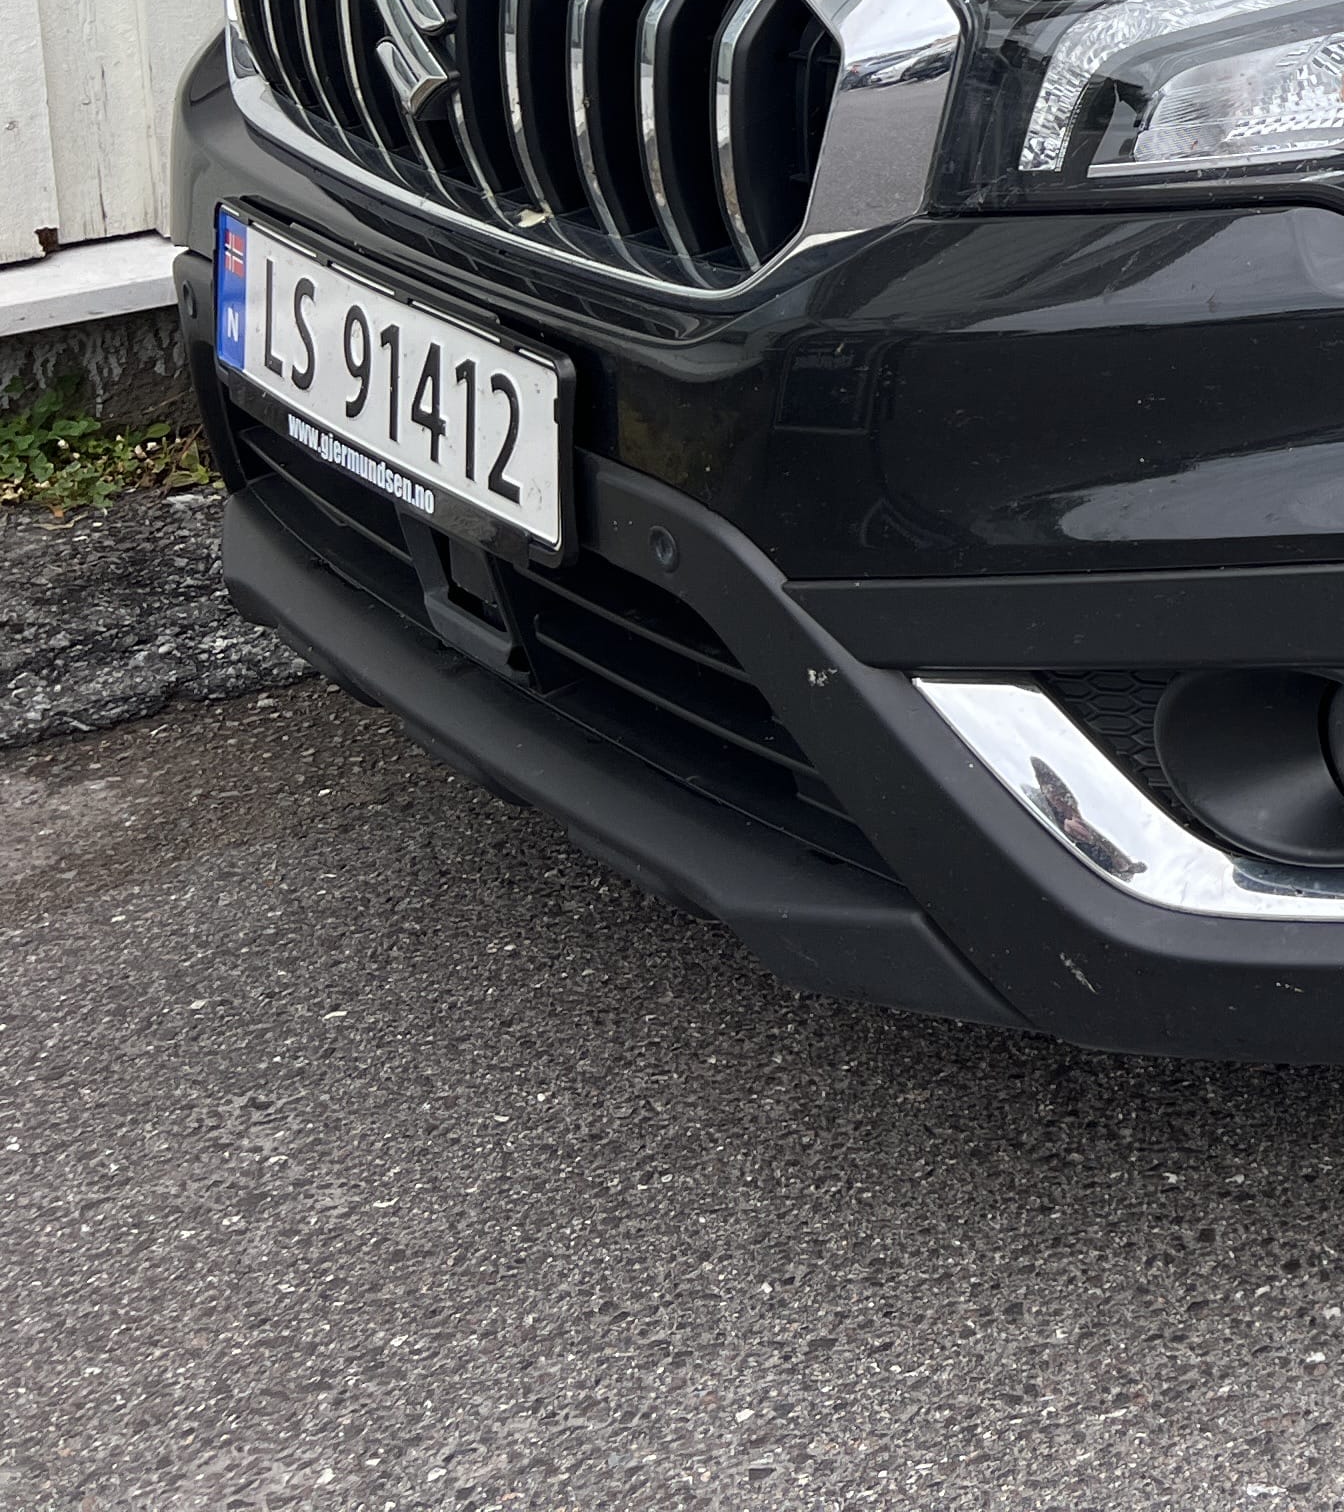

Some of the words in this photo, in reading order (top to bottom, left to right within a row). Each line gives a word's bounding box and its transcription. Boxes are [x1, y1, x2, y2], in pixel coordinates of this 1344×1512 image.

[226, 311, 240, 344] N
[264, 257, 316, 391] LS
[343, 304, 521, 505] 91412
[287, 413, 435, 515] www.gjermundsen.no
